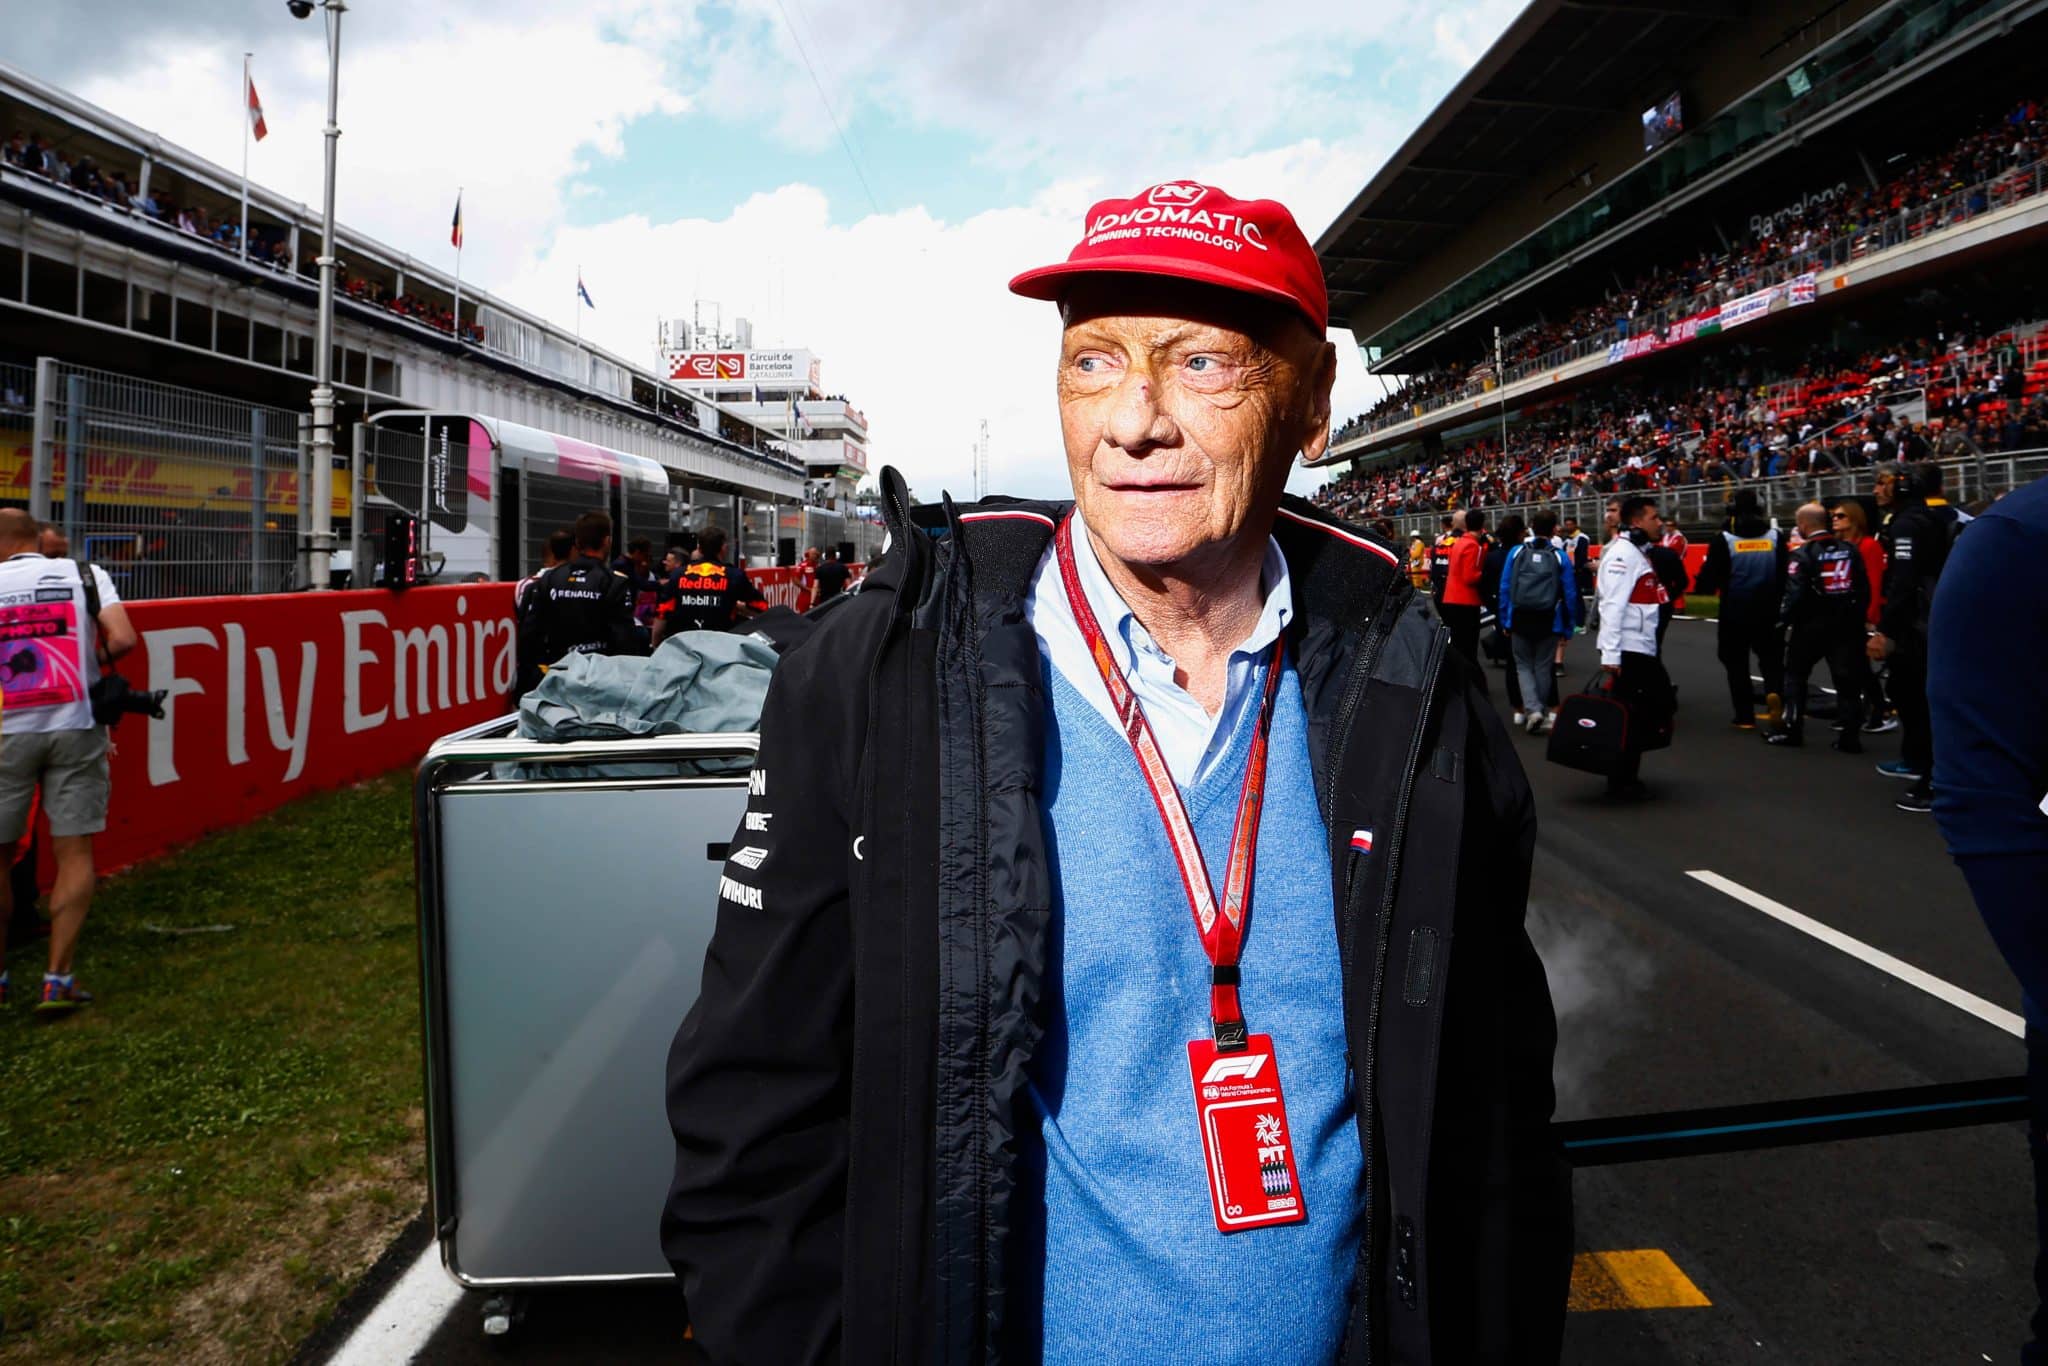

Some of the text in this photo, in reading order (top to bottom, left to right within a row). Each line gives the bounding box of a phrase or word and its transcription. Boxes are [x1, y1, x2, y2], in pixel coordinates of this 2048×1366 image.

[1089, 226, 1244, 252] WINNING TECHNOLOGY
[750, 353, 793, 361] Circuit de
[749, 362, 793, 370] Barcelona
[679, 577, 728, 591] Red Bull
[558, 589, 601, 600] RENAULT
[682, 595, 709, 606] Mobil
[141, 595, 518, 787] Fly Emira
[1258, 1145, 1287, 1163] PIT
